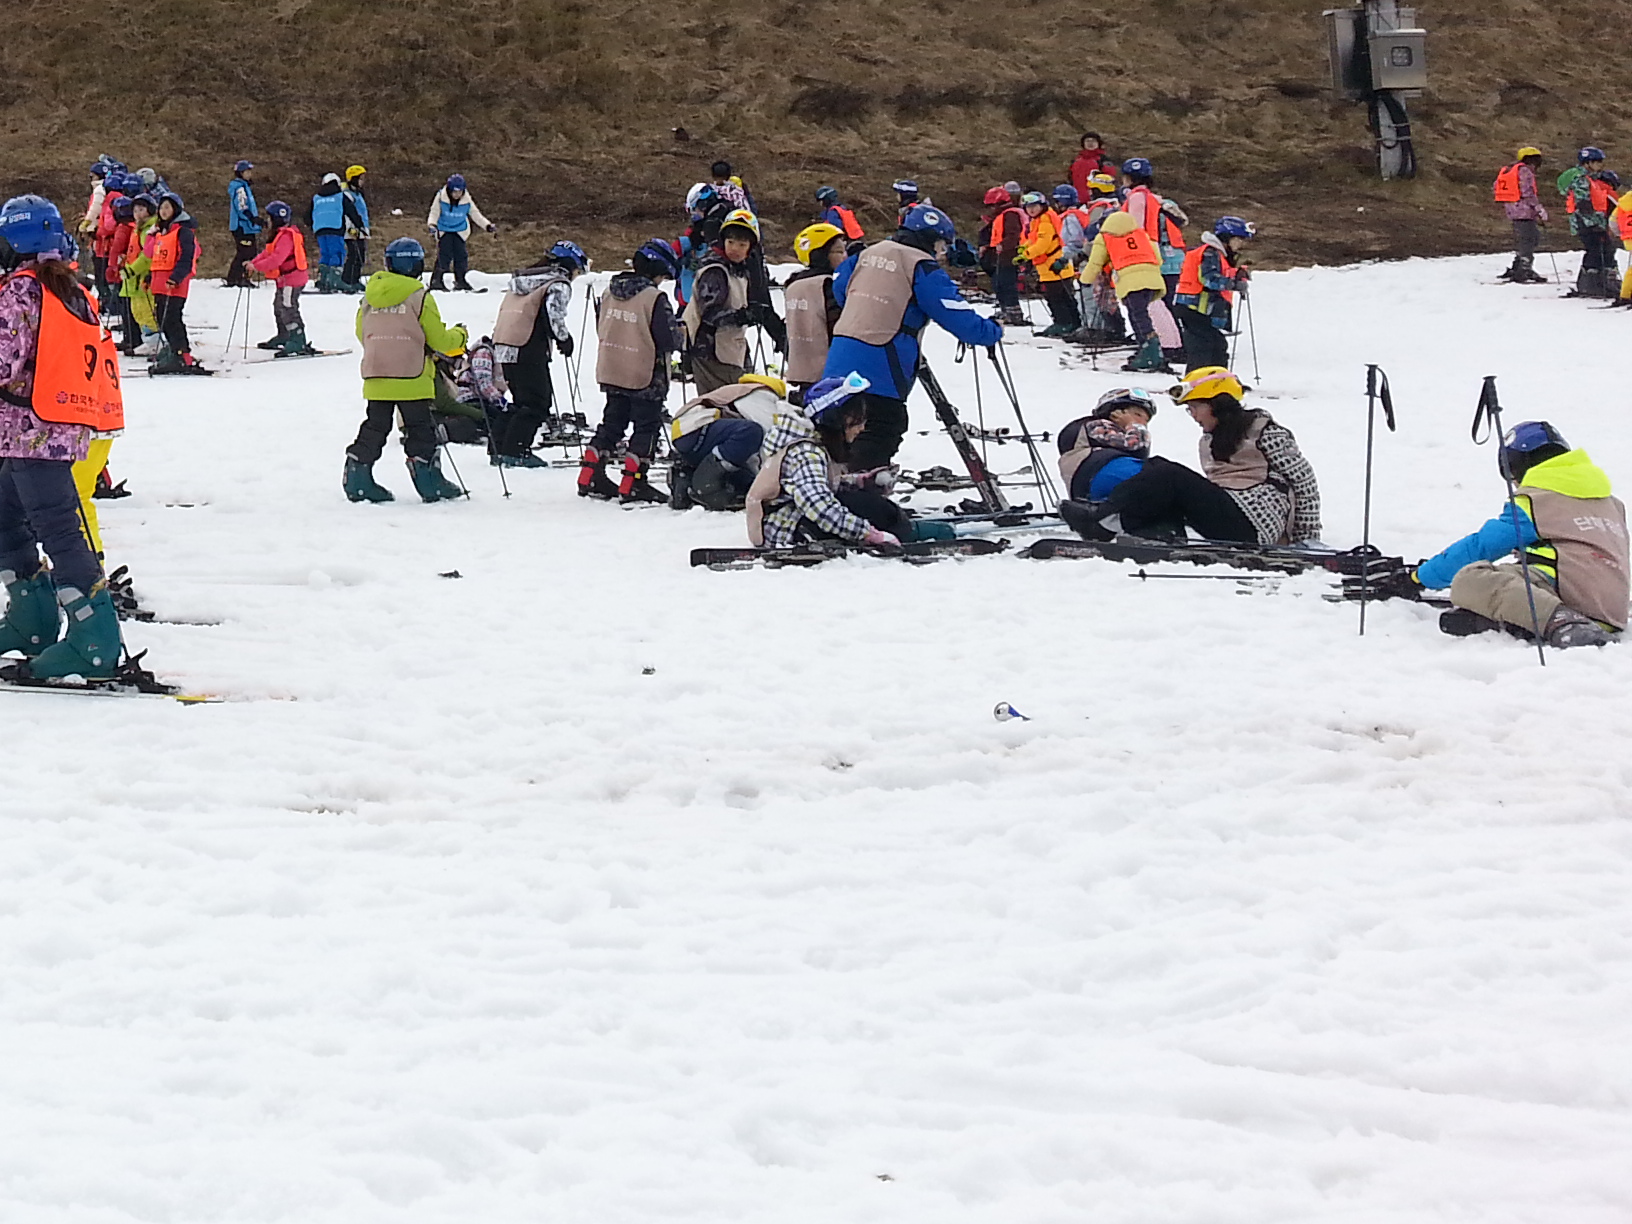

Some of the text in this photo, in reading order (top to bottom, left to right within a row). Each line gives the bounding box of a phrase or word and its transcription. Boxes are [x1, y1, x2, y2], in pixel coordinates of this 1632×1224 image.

[1126, 237, 1138, 249] 8
[84, 344, 98, 381] 9
[105, 359, 119, 390] 9
